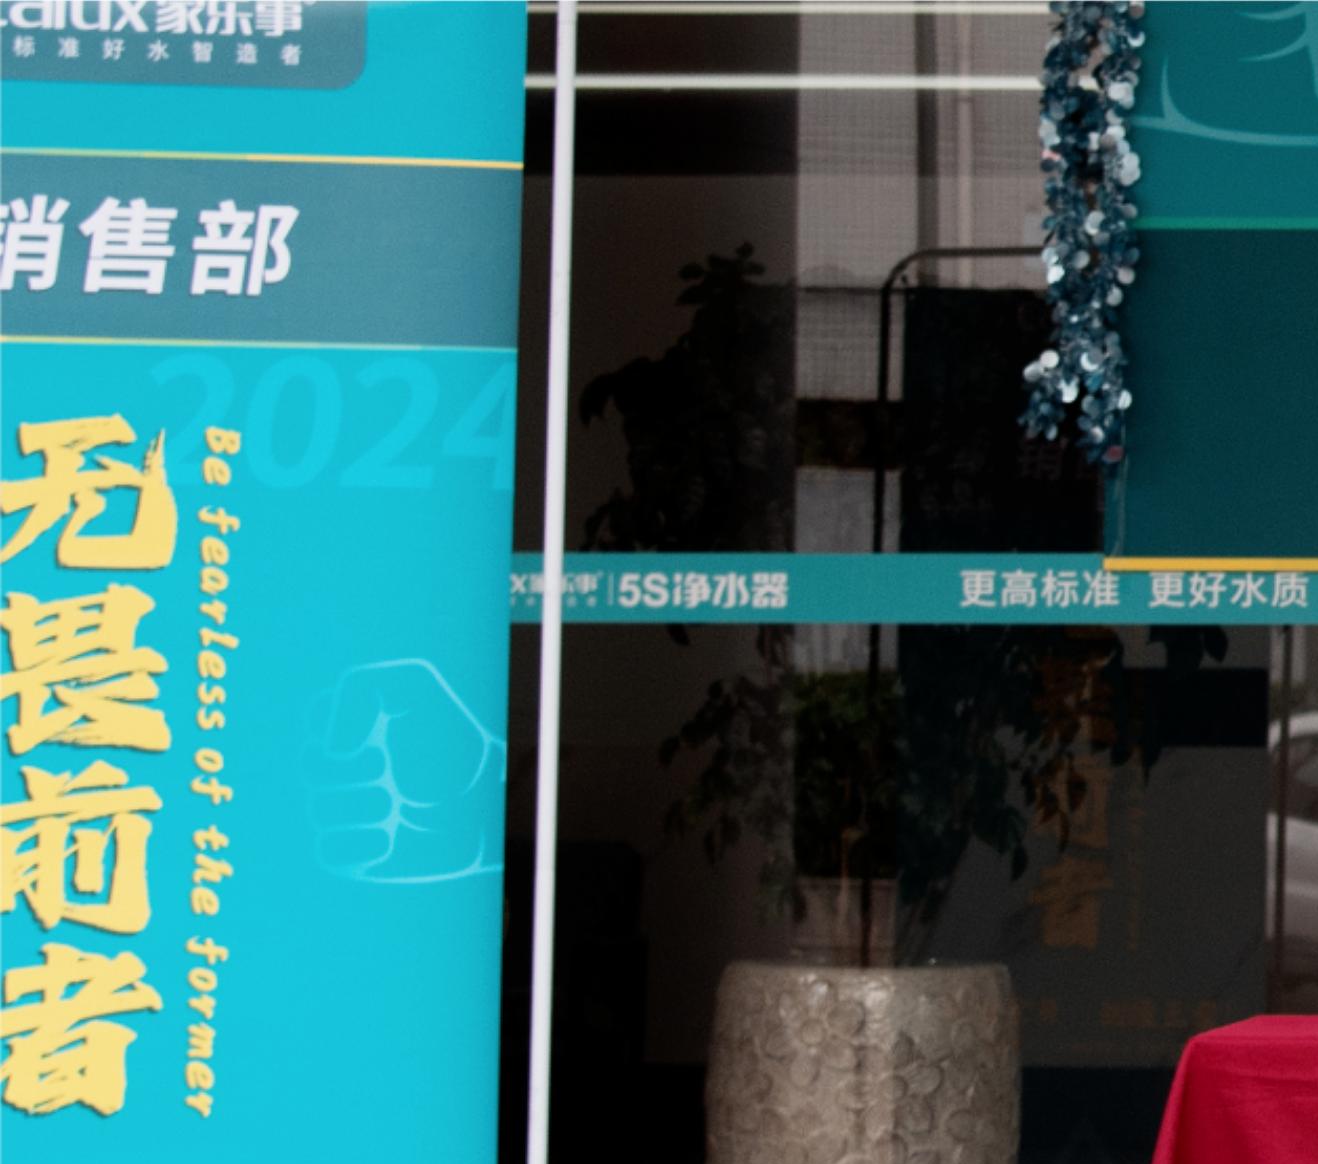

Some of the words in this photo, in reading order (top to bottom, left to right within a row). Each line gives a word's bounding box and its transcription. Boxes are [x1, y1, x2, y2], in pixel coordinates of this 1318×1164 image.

[12, 36, 302, 66] 标准好水智造者
[0, 194, 300, 296] 销售部
[203, 426, 241, 486] Be
[196, 506, 240, 730] fearless
[618, 571, 789, 609] 5S净水器
[959, 568, 1120, 610] 更高标准
[1148, 570, 1309, 609] 更好水质
[190, 748, 233, 805] of
[190, 826, 233, 916] the
[184, 936, 229, 1118] former
